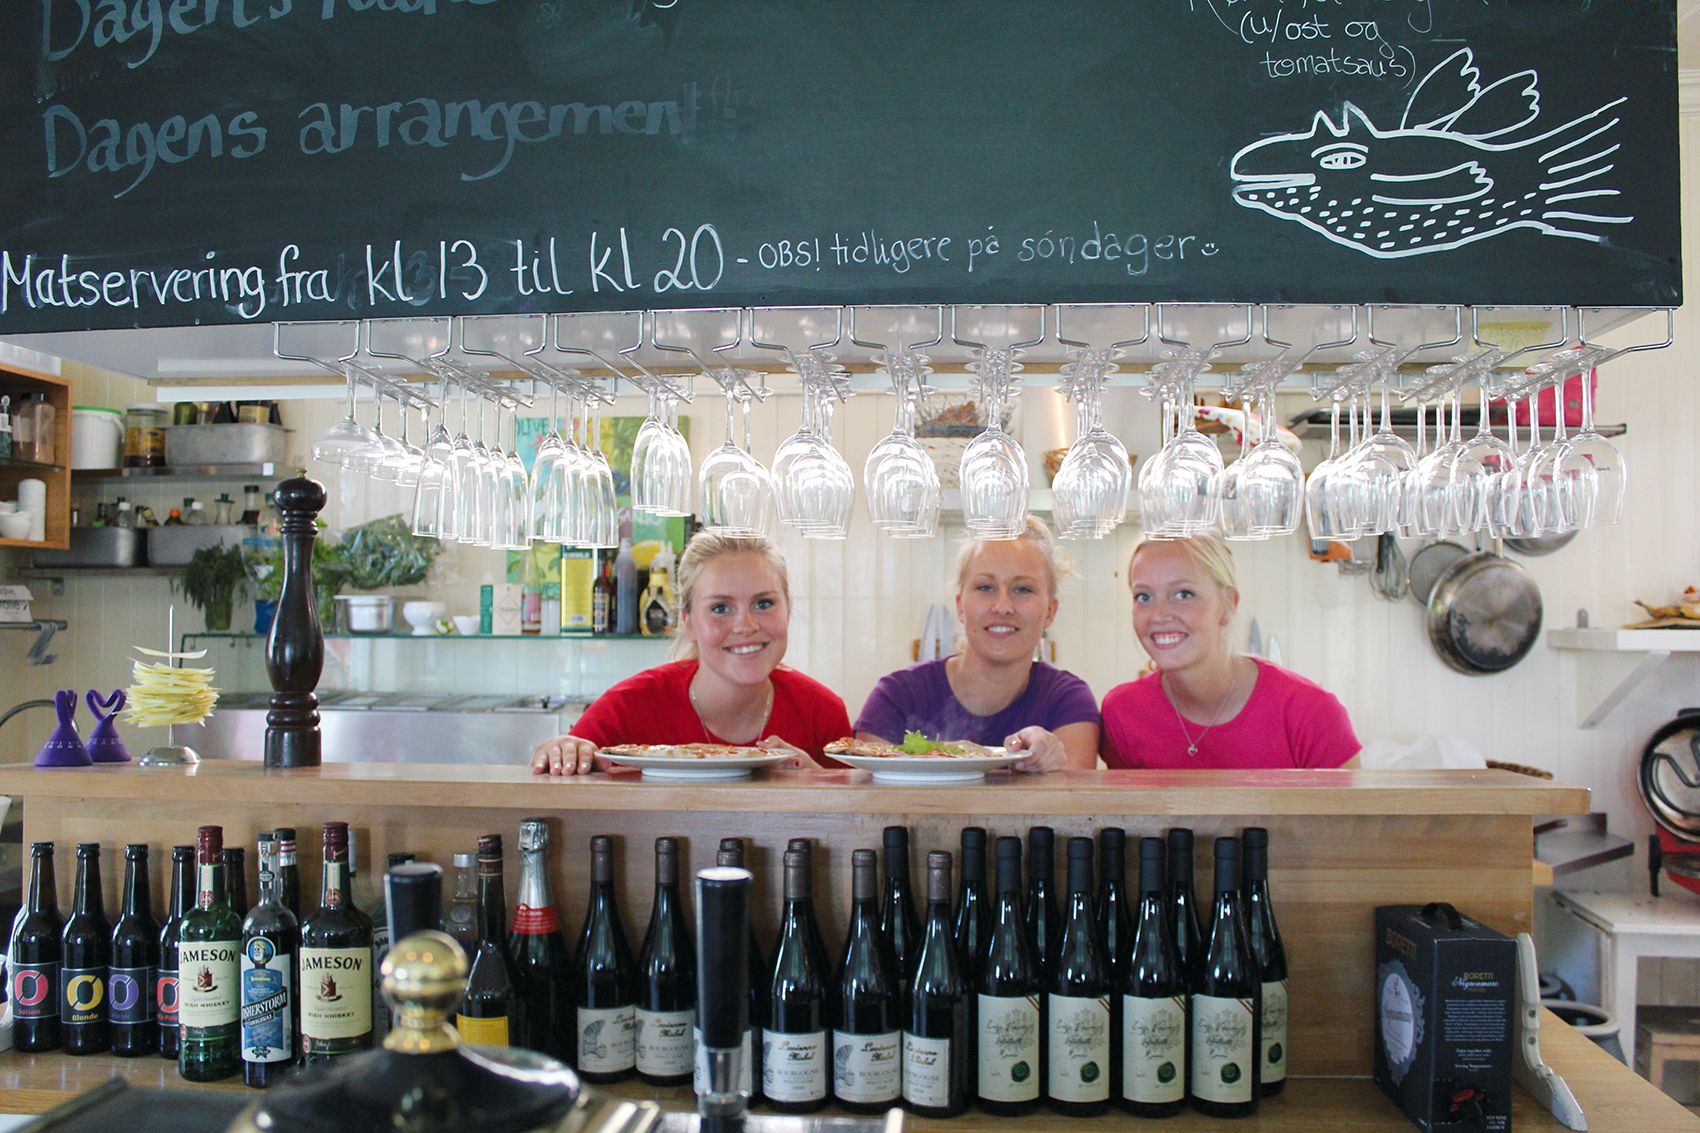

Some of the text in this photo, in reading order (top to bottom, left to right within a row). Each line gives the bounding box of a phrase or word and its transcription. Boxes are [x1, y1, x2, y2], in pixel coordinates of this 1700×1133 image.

[1345, 20, 1395, 58] og
[42, 104, 267, 199] Dagens
[2, 250, 264, 319] Matservering
[276, 244, 335, 308] fra
[366, 240, 414, 306] kl
[440, 240, 488, 300] 13
[510, 237, 574, 296] til
[590, 227, 641, 293] kl
[653, 224, 724, 293] 20
[758, 238, 820, 272] OBS!
[830, 229, 951, 273] tidligere
[180, 949, 236, 964] JAMESON
[302, 956, 362, 971] JAMESON
[72, 1013, 98, 1021] Blonde
